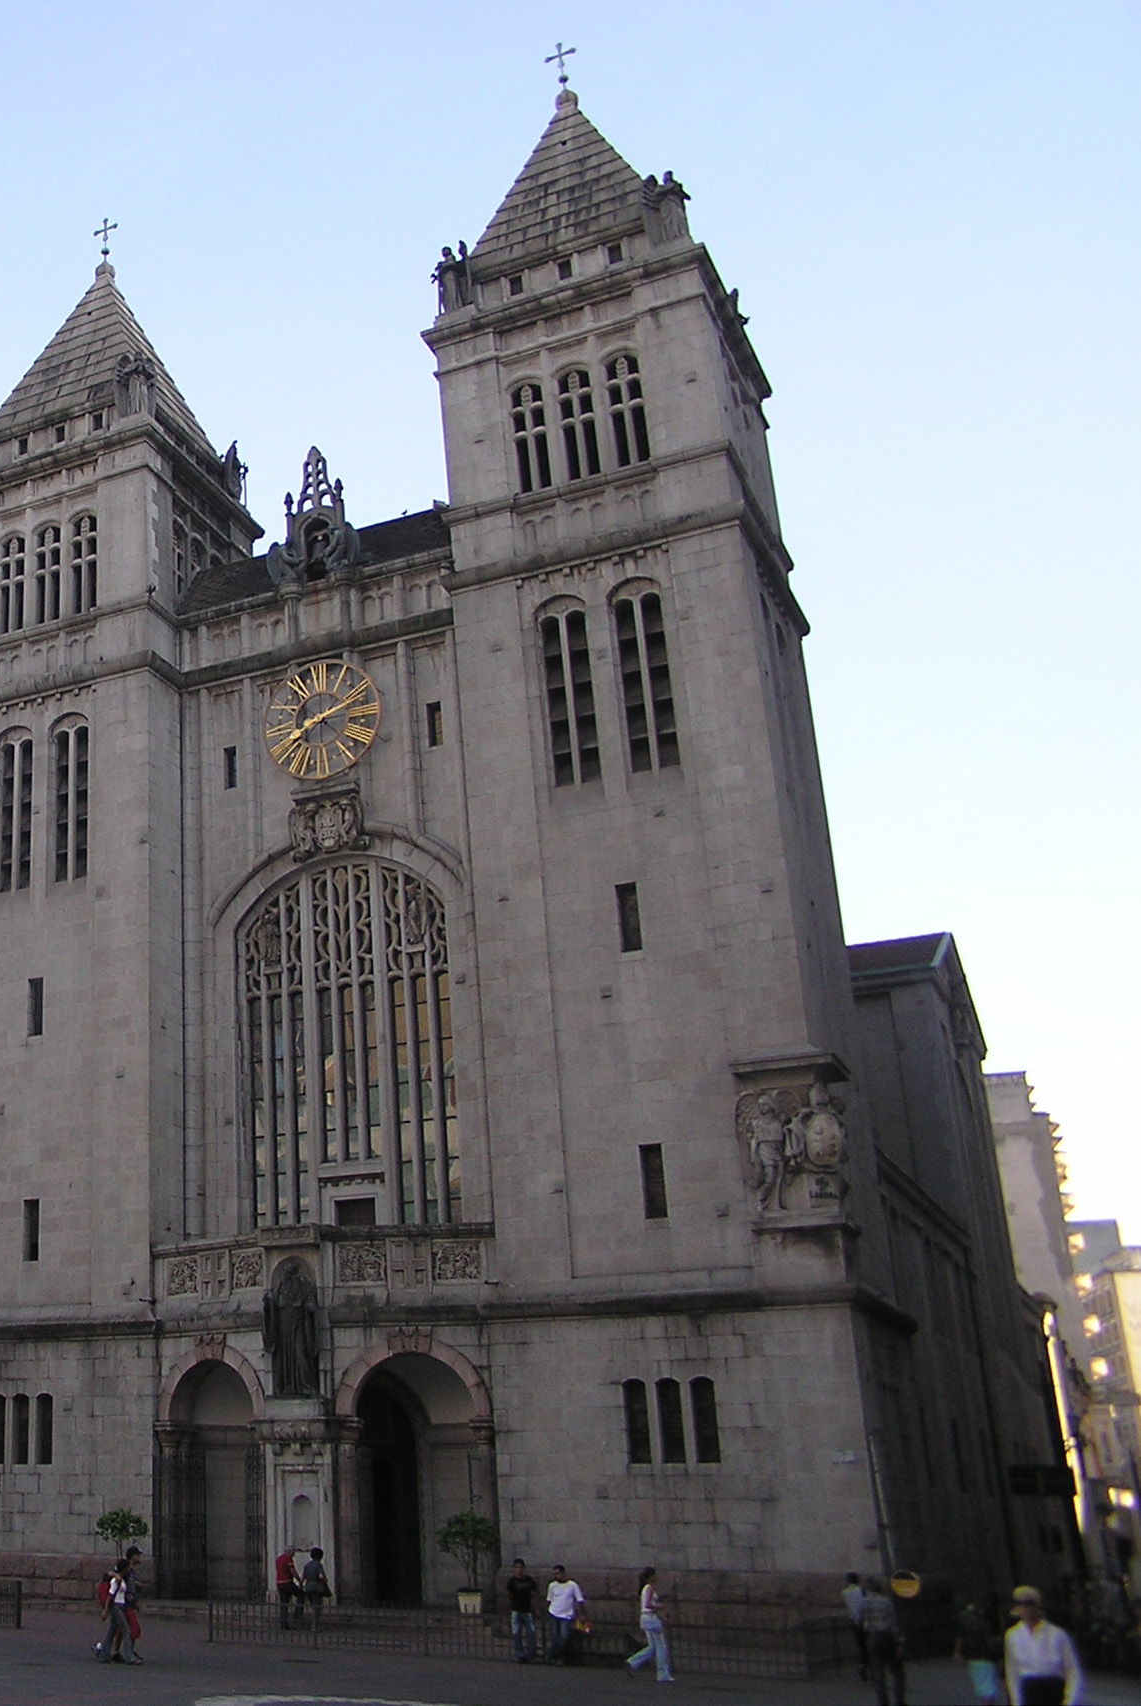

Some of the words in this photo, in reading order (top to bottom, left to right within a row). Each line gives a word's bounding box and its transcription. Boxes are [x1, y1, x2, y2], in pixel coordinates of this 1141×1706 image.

[310, 663, 327, 692] XII
[333, 665, 347, 692] I
[349, 703, 378, 718] III
